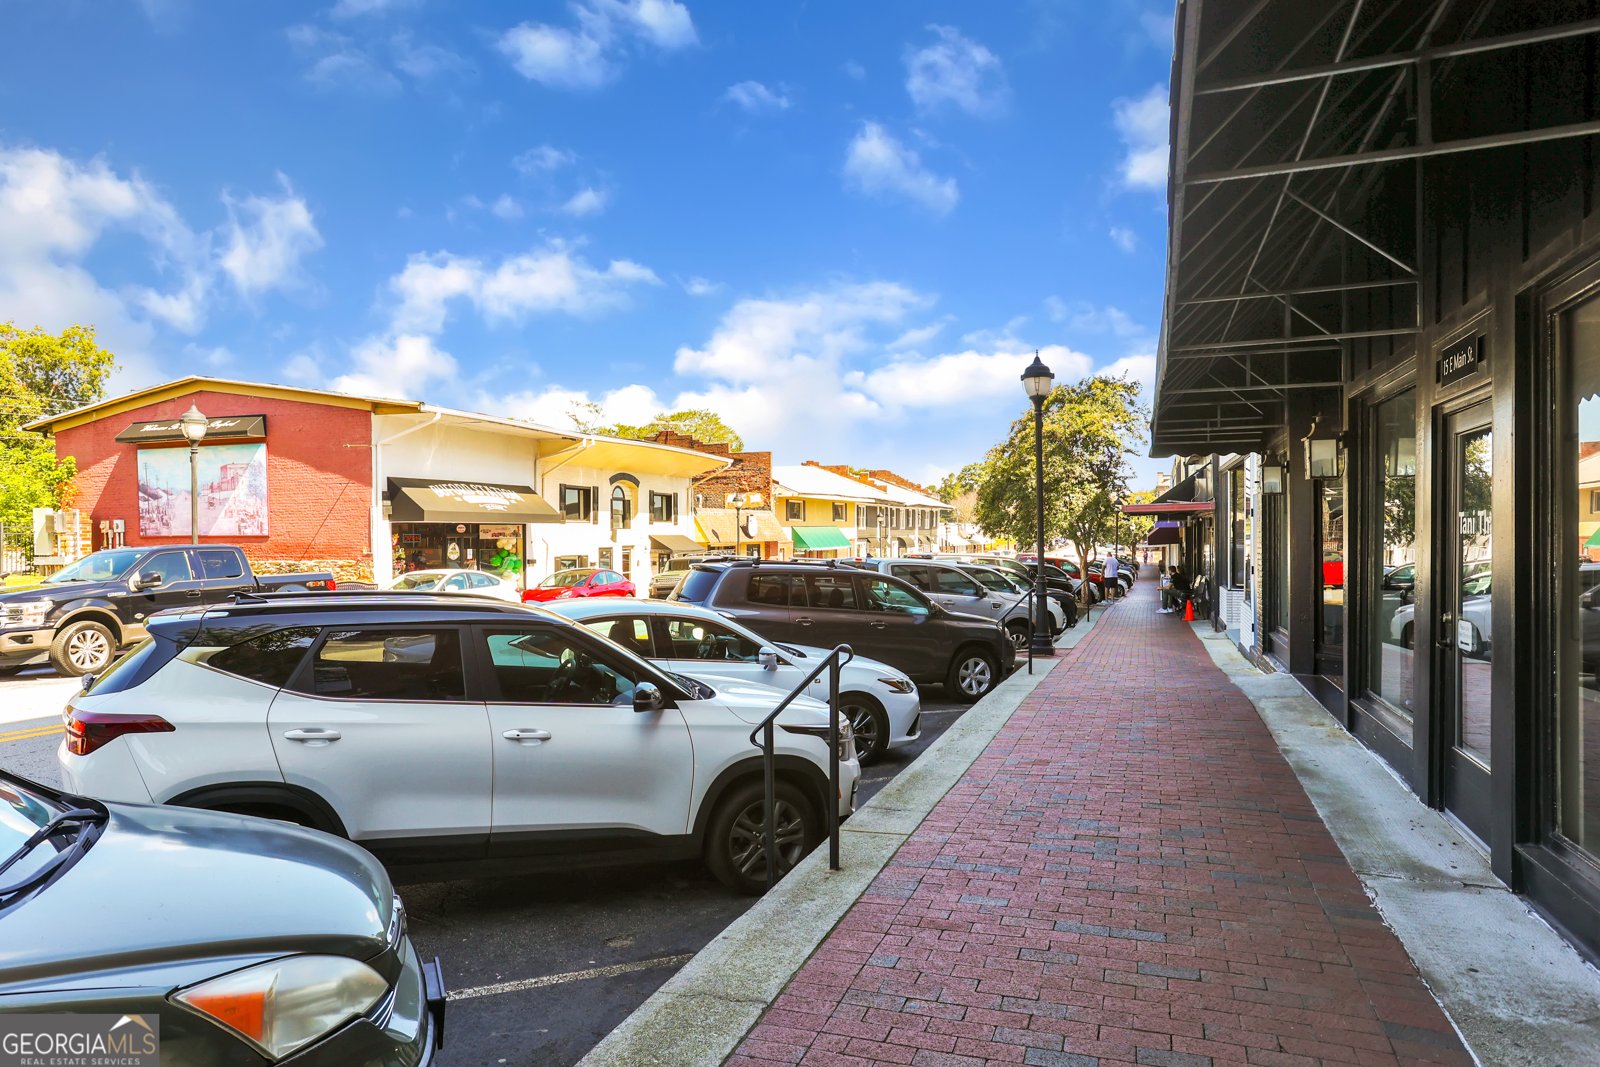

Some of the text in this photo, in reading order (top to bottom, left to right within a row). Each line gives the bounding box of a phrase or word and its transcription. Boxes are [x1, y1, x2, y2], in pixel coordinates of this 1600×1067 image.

[1443, 359, 1448, 376] 15
[1449, 356, 1453, 373] E
[1453, 350, 1467, 371] Main
[1459, 510, 1475, 535] Tani
